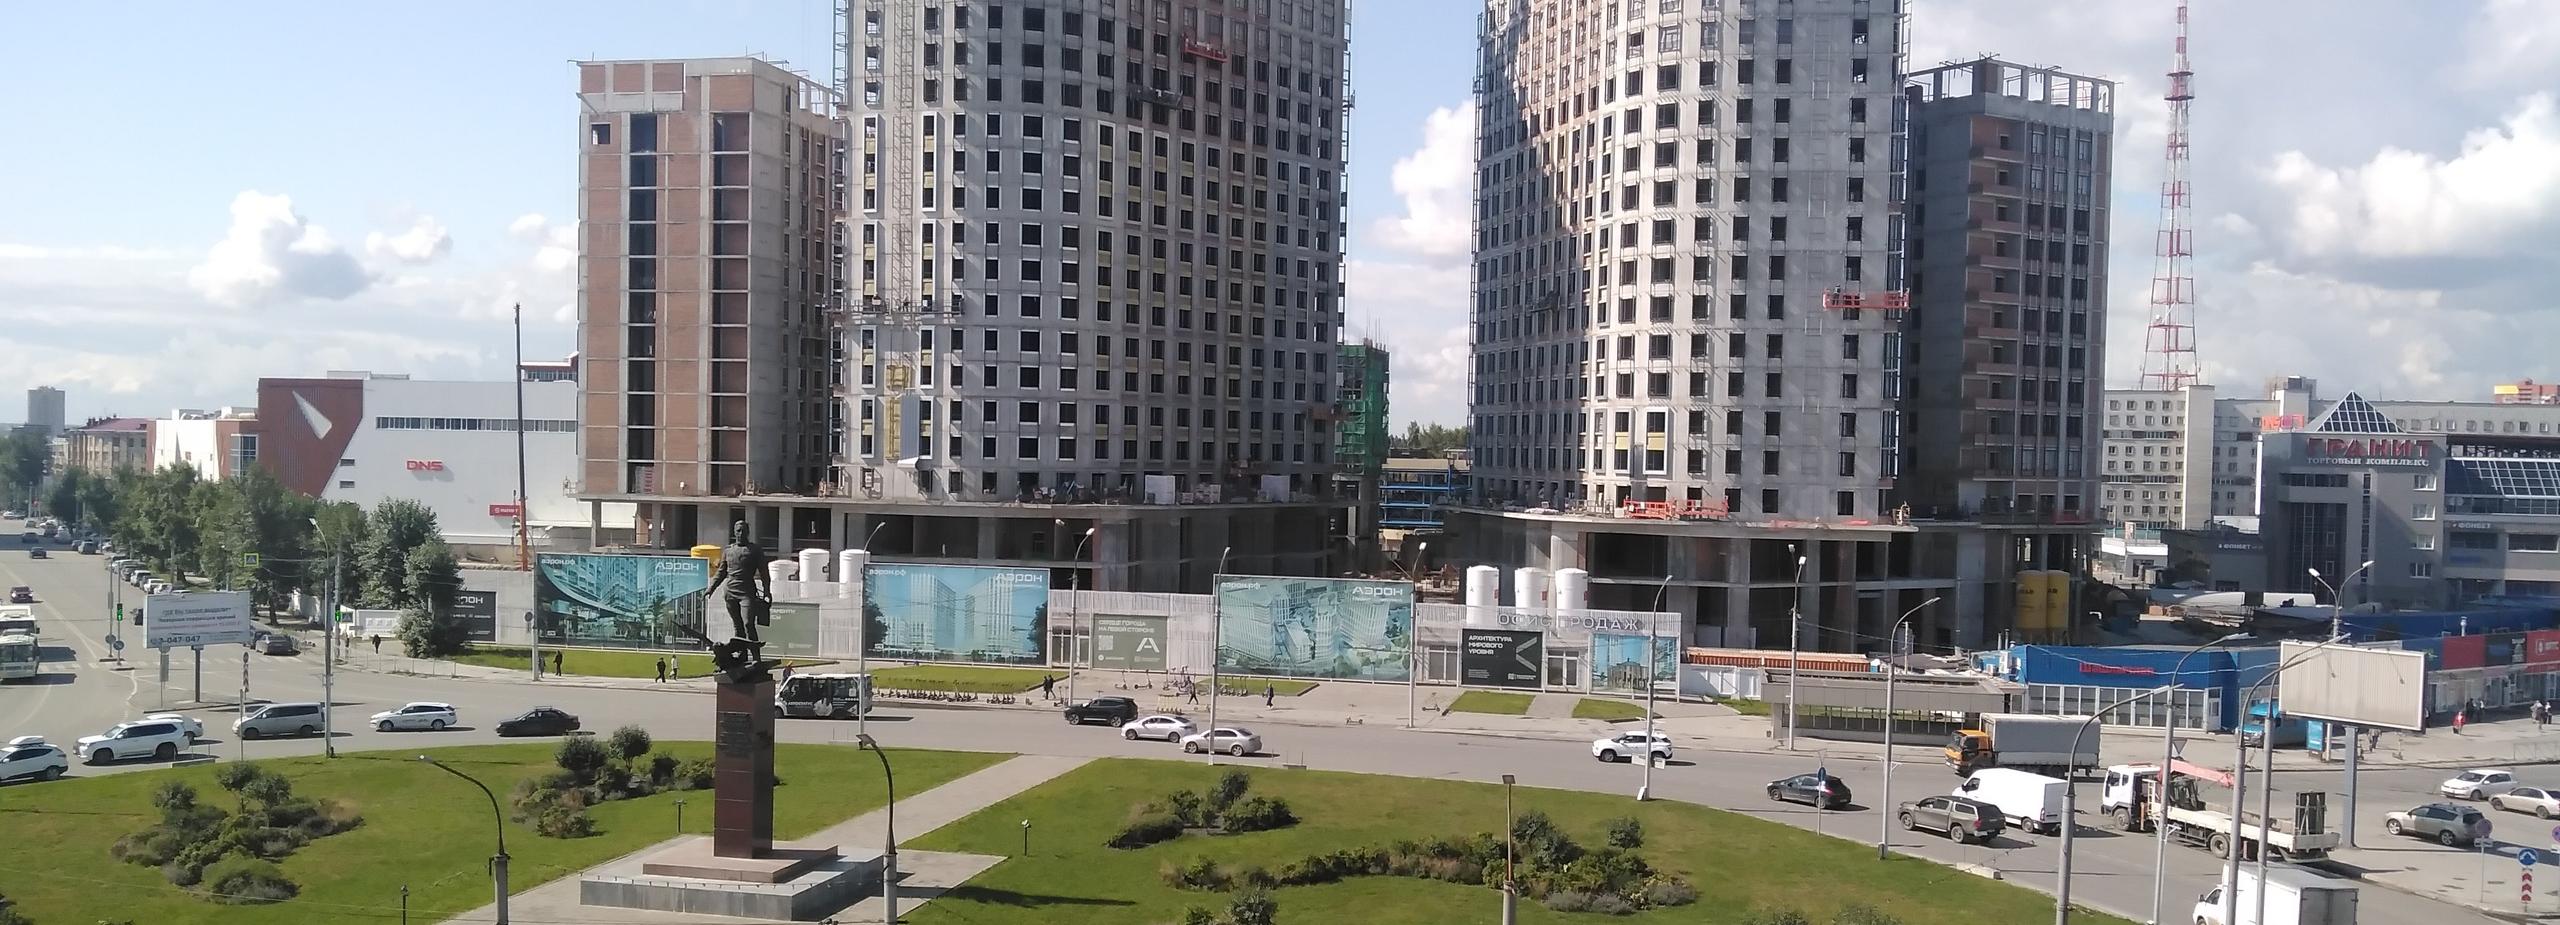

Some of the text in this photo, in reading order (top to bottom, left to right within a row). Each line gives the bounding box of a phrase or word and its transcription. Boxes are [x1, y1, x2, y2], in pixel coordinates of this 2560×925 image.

[2307, 438, 2433, 457] ГРАНИТ
[406, 460, 444, 471] DNS
[2366, 458, 2429, 466] КОМПЛЕКС
[1468, 635, 1513, 643] АРХИТЕКТУРА
